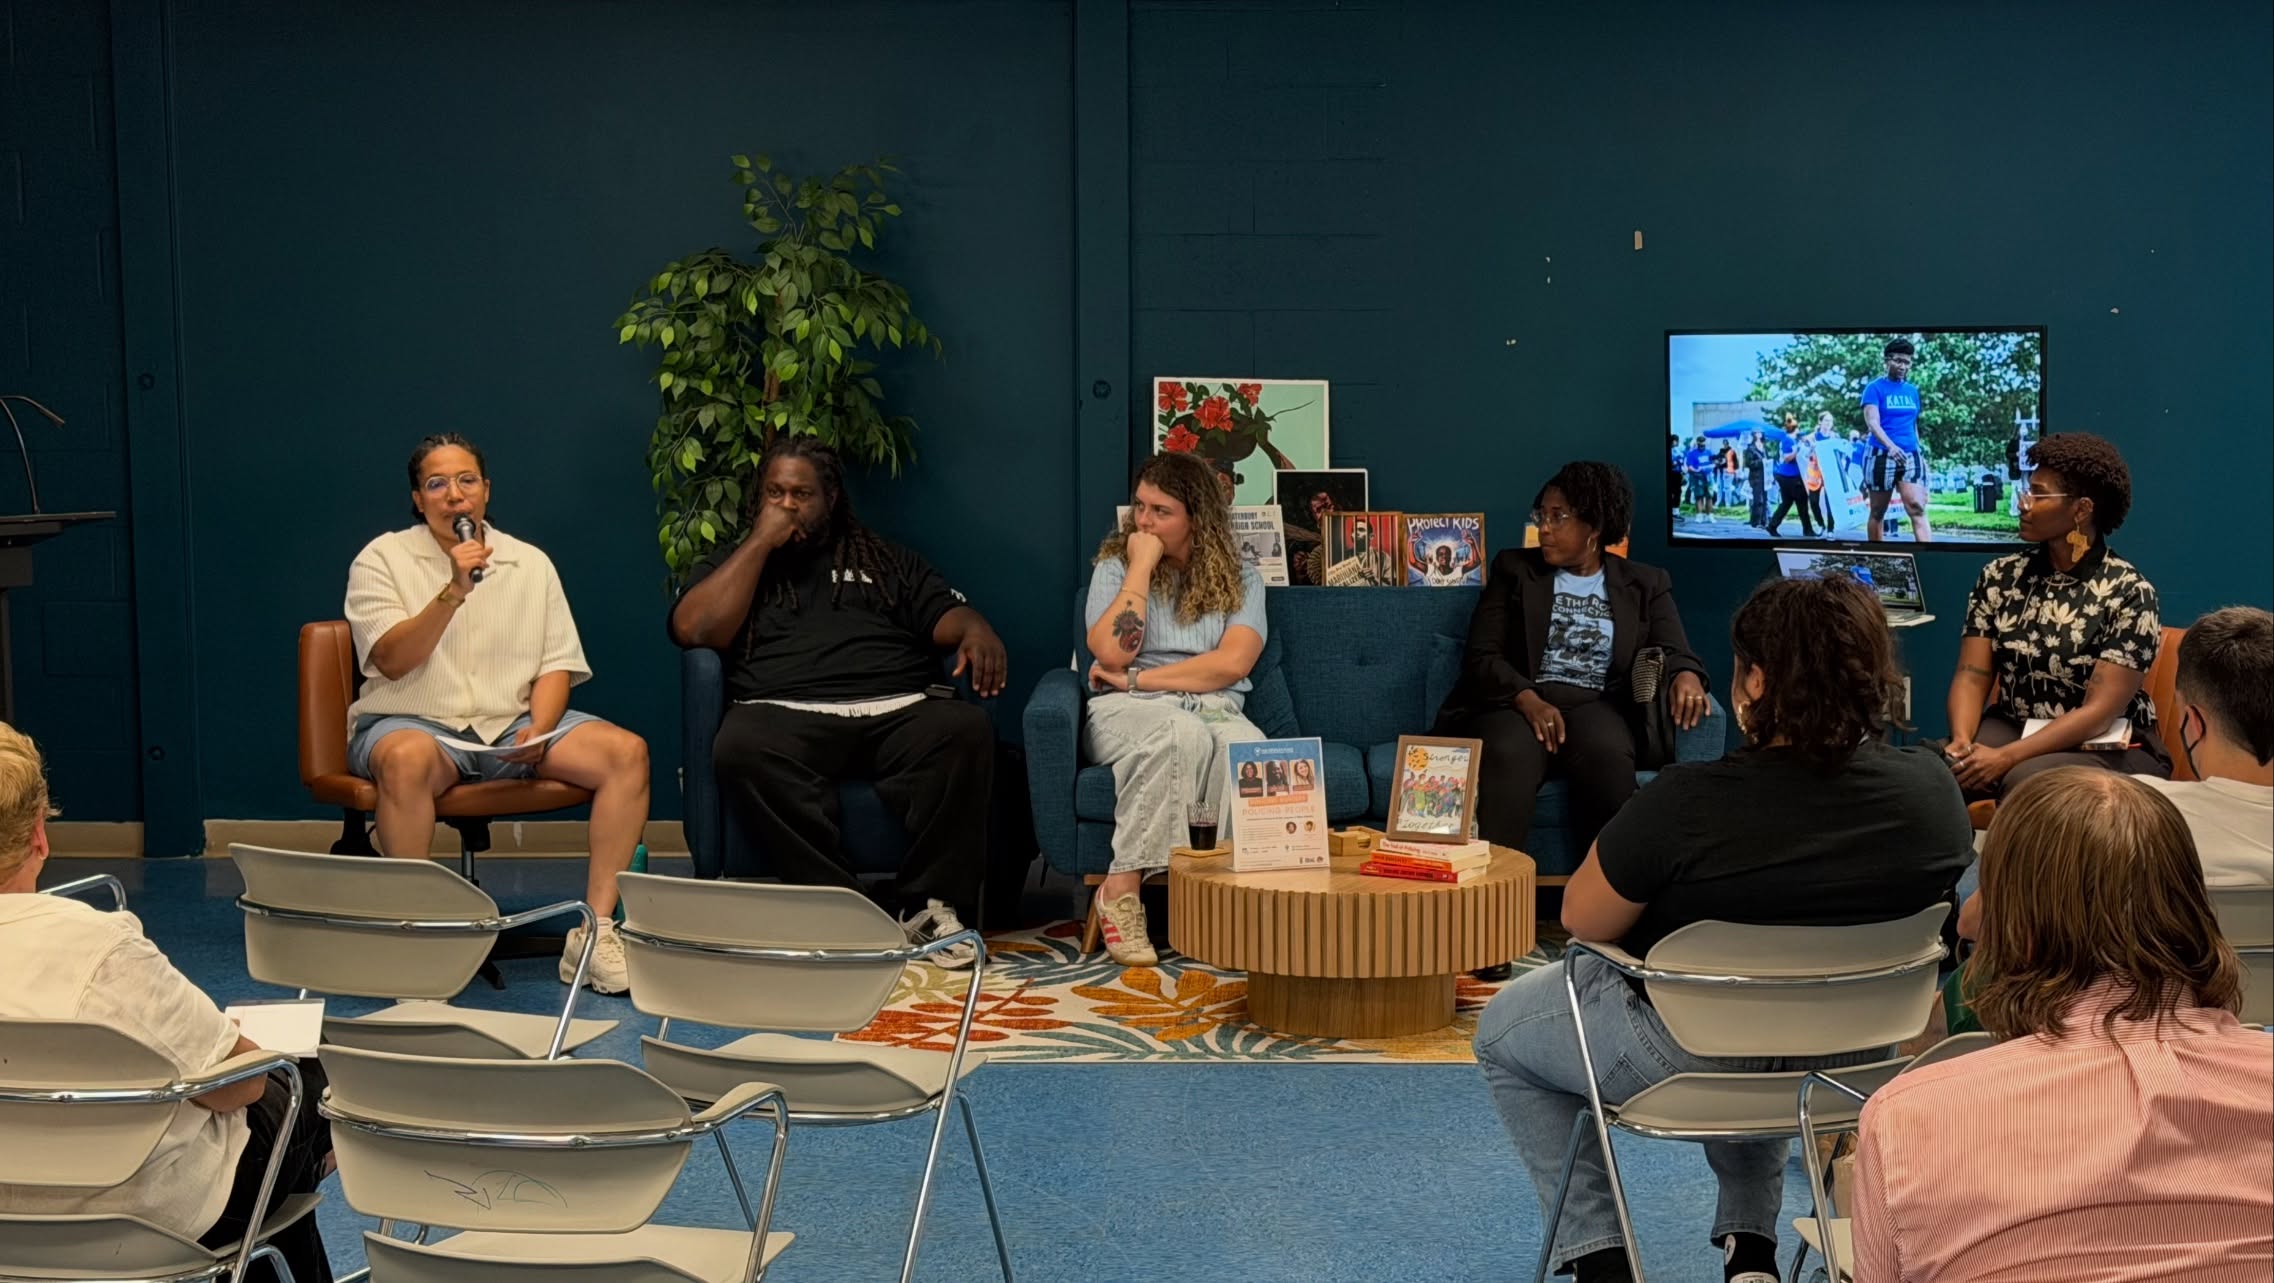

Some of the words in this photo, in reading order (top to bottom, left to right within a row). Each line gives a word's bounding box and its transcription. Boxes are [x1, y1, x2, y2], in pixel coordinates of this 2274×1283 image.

[1886, 394, 1915, 406] KATAL
[1231, 511, 1258, 520] ATERBURY
[1251, 521, 1275, 530] SCHOOL
[1452, 517, 1480, 530] KIDS
[1552, 604, 1614, 617] CONNECTIO
